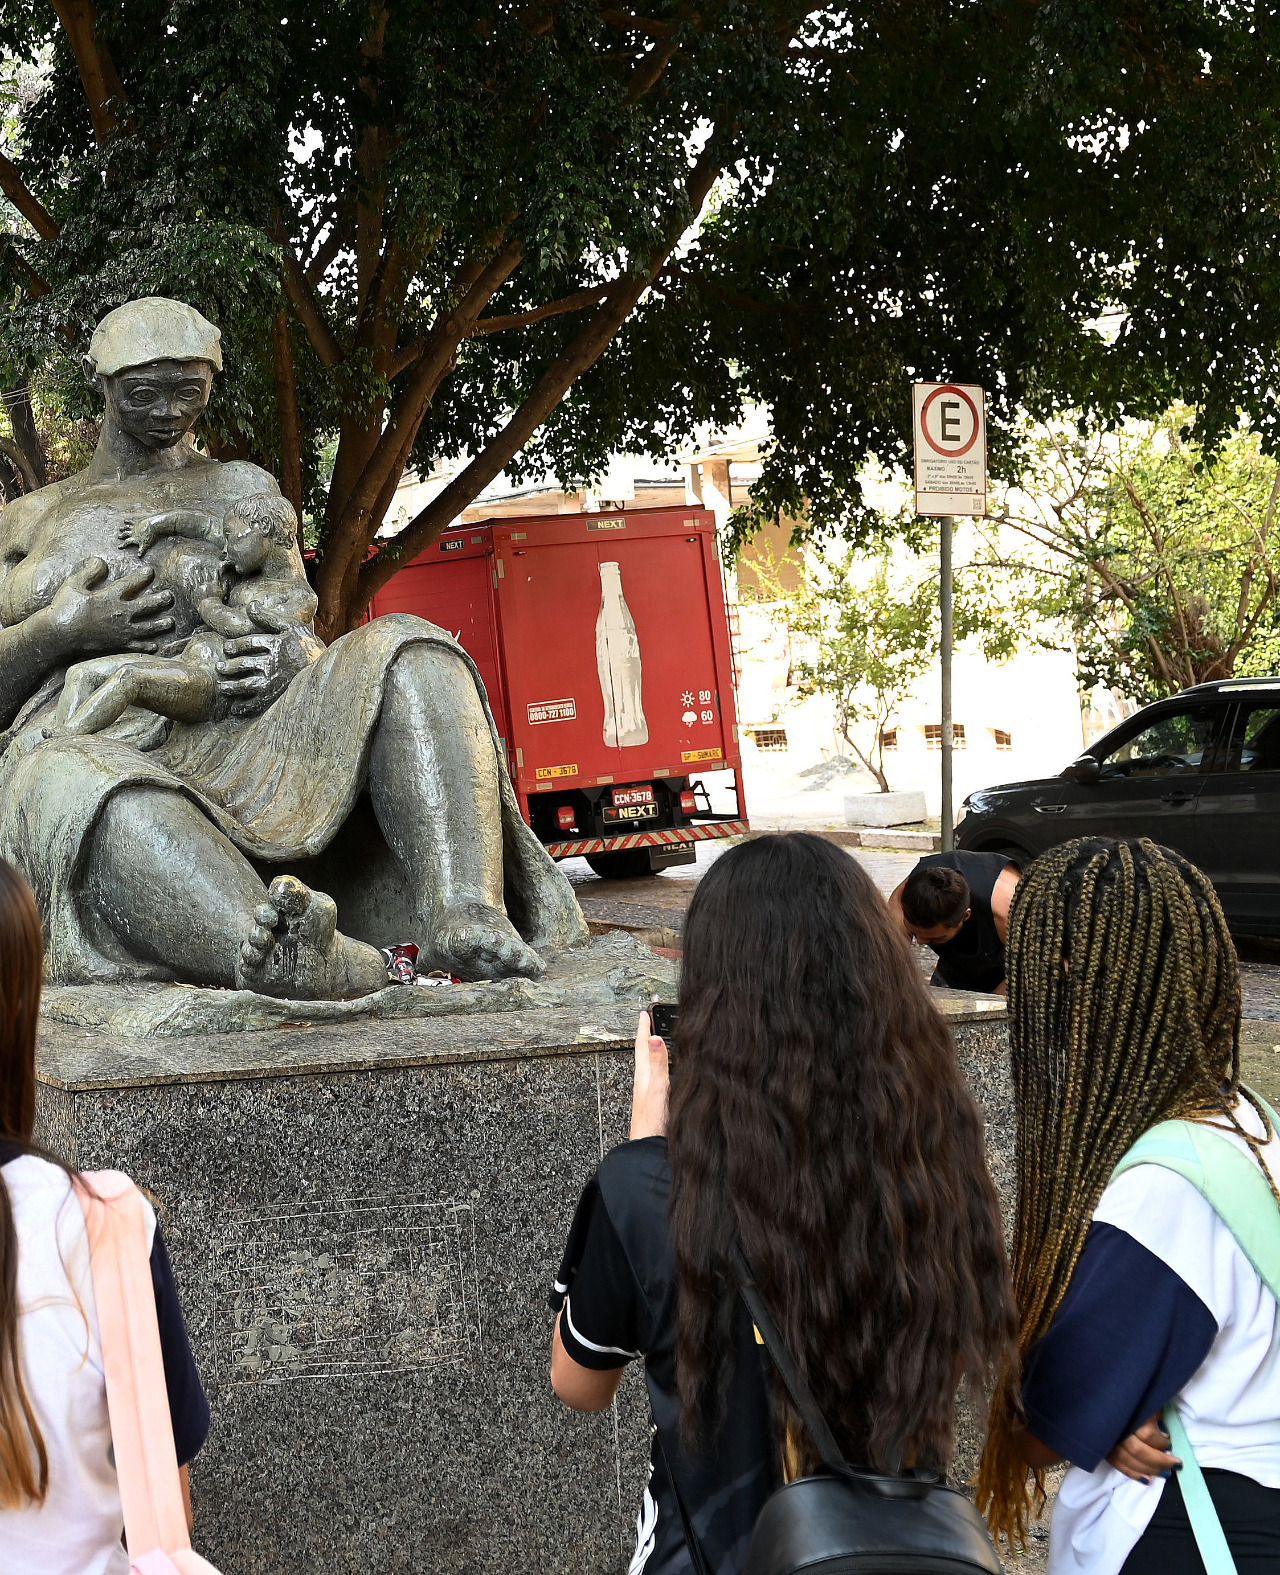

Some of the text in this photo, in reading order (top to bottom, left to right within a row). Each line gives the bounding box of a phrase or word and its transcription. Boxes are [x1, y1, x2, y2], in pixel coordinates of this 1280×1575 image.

[941, 402, 960, 441] E
[957, 465, 966, 473] 2h
[598, 520, 622, 528] NEXT
[446, 541, 462, 550] NEXT
[699, 690, 711, 701] 80
[560, 708, 574, 717] 1100
[701, 710, 713, 721] 60
[619, 805, 655, 818] NEXT
